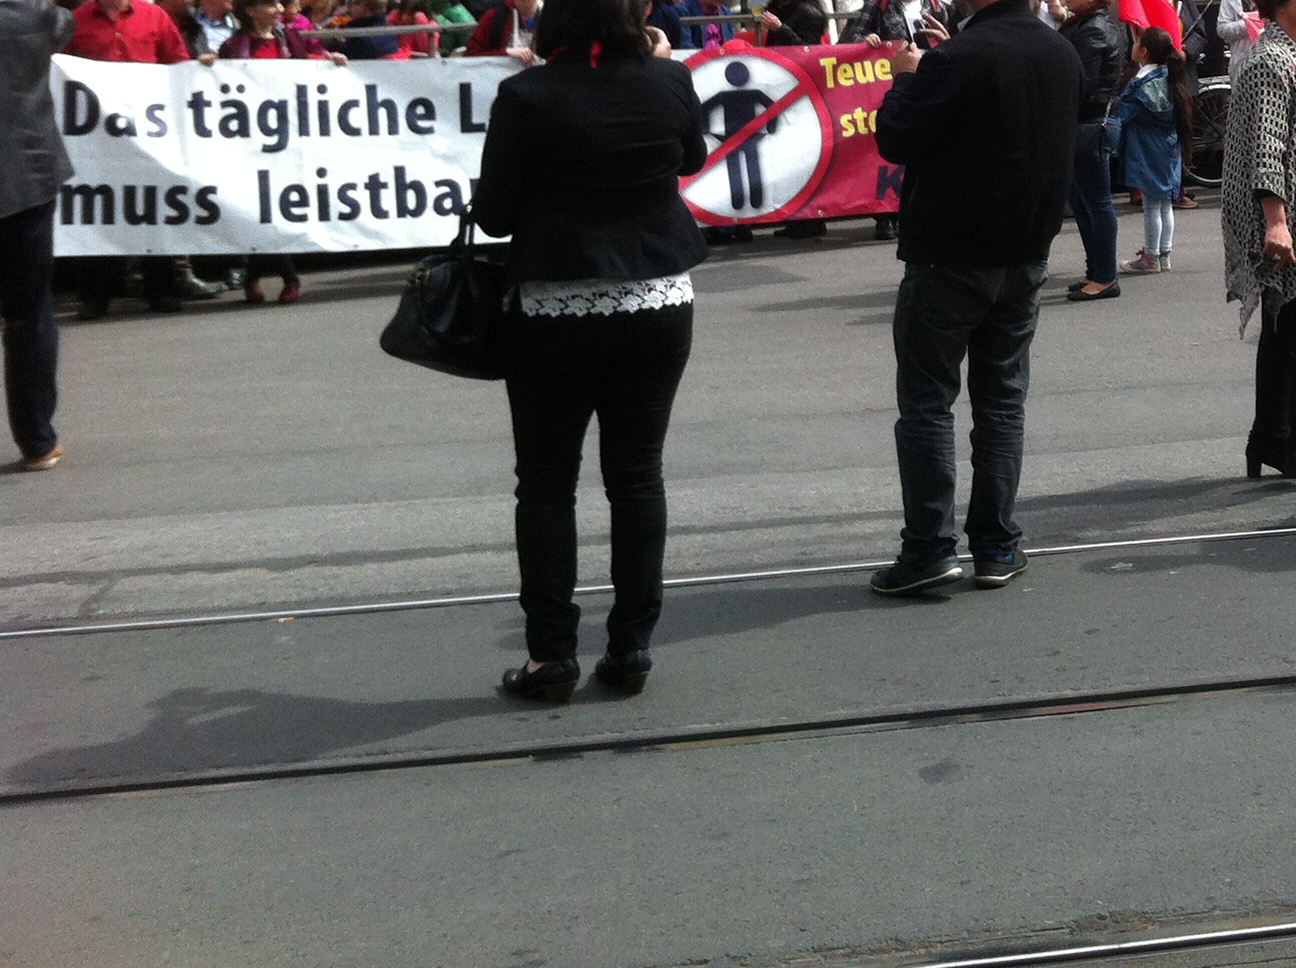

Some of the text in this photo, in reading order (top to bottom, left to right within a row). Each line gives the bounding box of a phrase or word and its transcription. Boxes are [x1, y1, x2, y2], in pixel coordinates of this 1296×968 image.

[819, 56, 893, 89] Teue
[62, 78, 169, 138] Das
[186, 82, 438, 154] tägliche
[59, 180, 222, 227] muss
